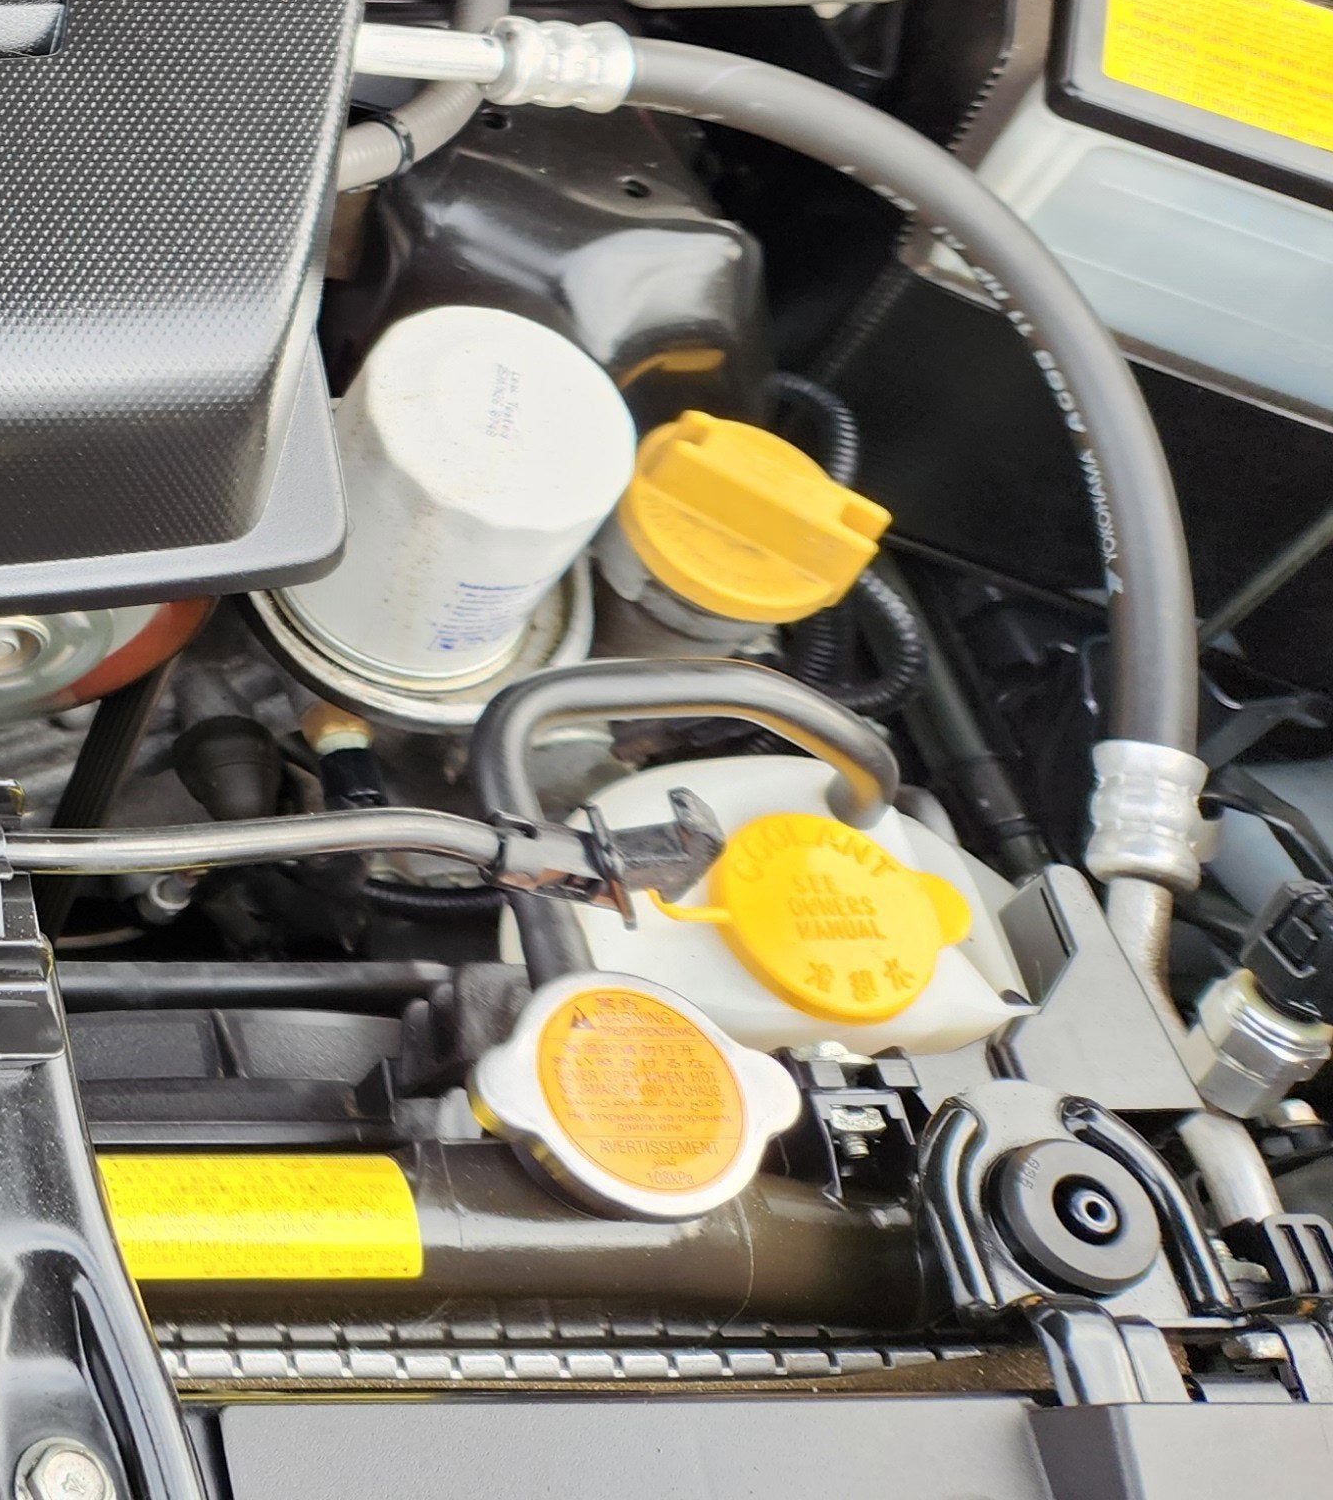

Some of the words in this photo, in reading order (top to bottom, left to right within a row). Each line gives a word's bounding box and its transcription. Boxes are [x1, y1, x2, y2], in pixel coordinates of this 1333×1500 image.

[1077, 447, 1119, 567] YOKOHAMA
[732, 818, 899, 884] COOLANT
[791, 873, 840, 894] SEE
[795, 918, 888, 940] MANUAL
[594, 1011, 674, 1025] WARNING
[602, 1069, 638, 1082] OPEN
[640, 1070, 685, 1083] WHEN
[599, 1140, 720, 1156] AVERTISSEMENT
